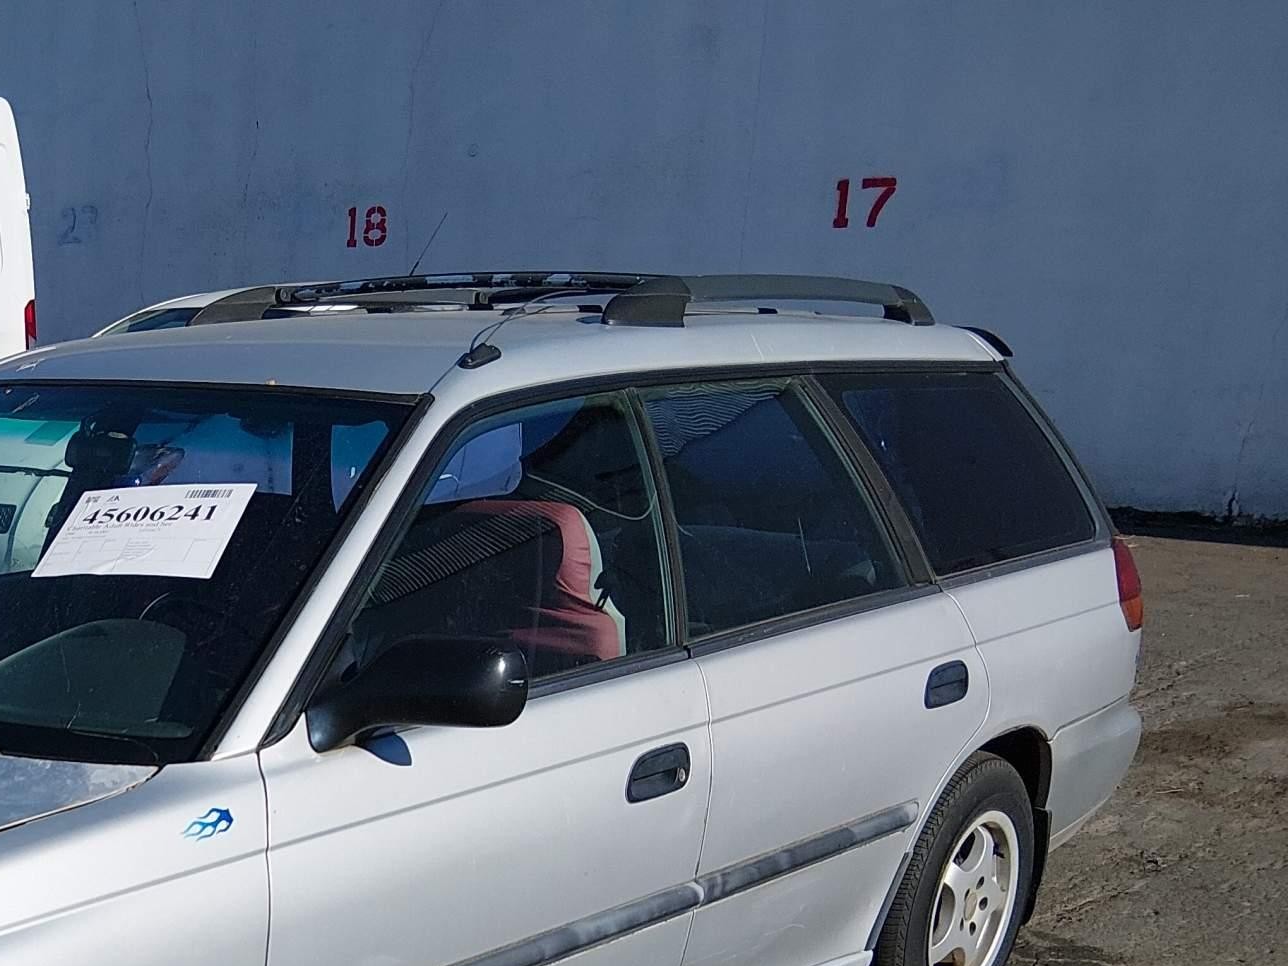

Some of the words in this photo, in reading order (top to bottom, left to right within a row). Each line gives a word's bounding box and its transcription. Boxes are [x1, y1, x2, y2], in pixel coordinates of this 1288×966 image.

[832, 177, 897, 228] 17
[346, 205, 388, 248] 18
[82, 504, 218, 524] 45606241
